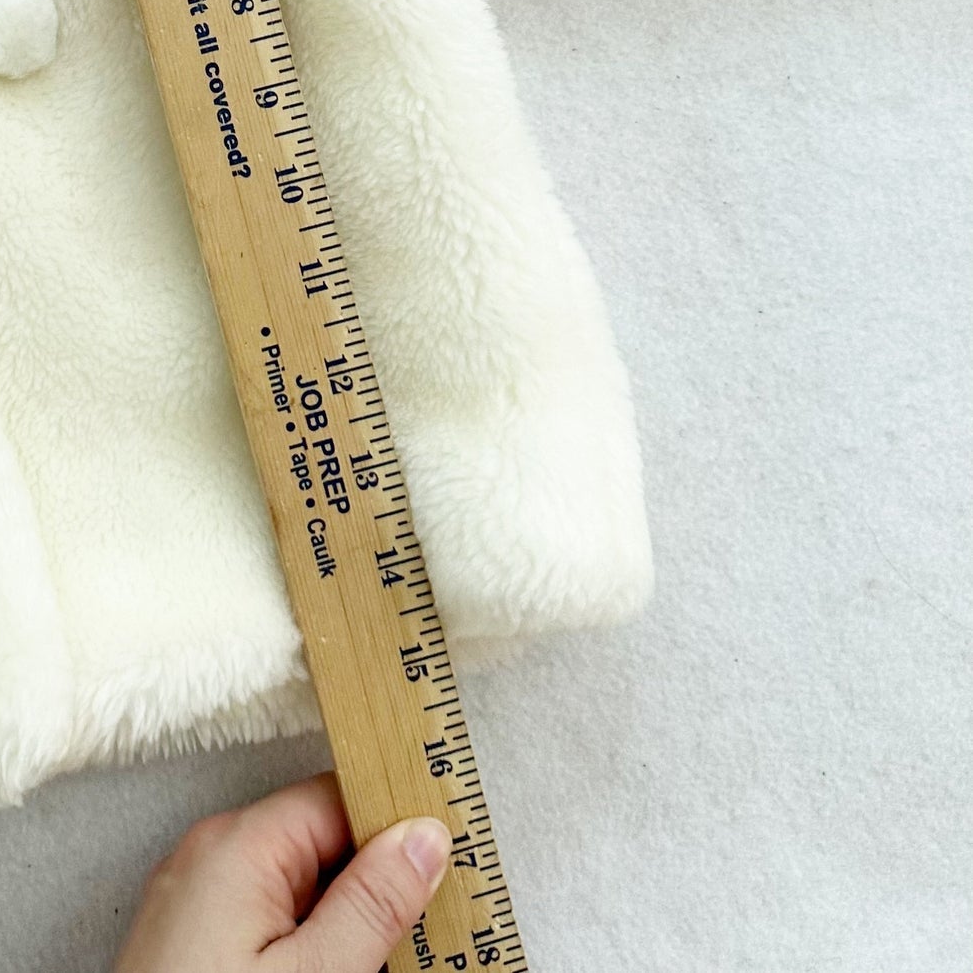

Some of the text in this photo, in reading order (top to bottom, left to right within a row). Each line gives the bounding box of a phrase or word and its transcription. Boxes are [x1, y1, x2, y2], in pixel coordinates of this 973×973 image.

[194, 22, 219, 55] all
[205, 62, 251, 178] covered?
[255, 91, 279, 109] 9
[274, 163, 304, 204] 10
[298, 258, 329, 299] 11
[324, 354, 354, 395] 12
[261, 344, 337, 579] Primer Tape Caulk
[296, 374, 350, 515] JOB PREP
[349, 450, 379, 491] 13
[374, 546, 405, 589] 14
[399, 642, 429, 682] 15
[423, 736, 453, 777] 16
[452, 831, 478, 869] 17
[411, 911, 436, 970] rush
[471, 924, 500, 966] 18
